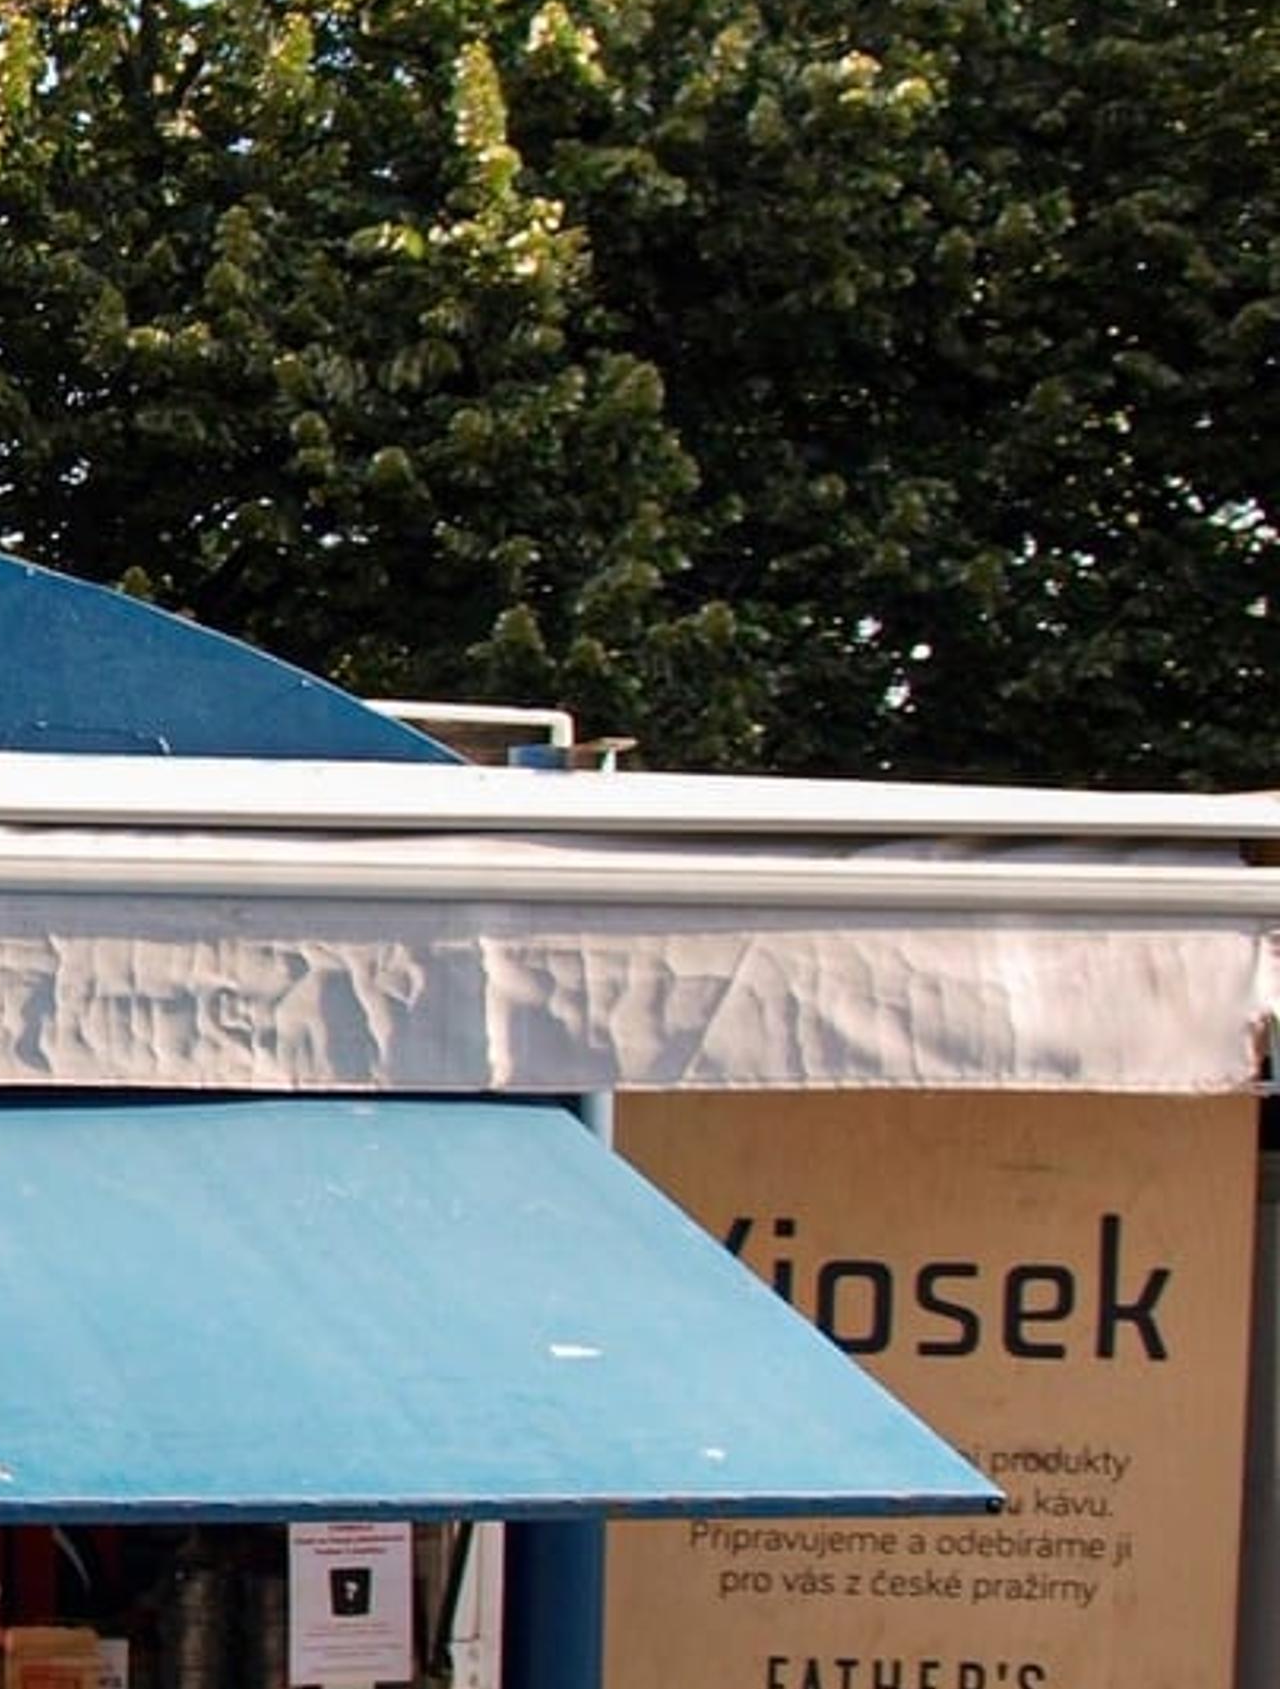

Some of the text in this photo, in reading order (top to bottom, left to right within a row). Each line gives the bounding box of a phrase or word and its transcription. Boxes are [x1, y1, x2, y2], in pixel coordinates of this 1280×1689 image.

[724, 1214, 1170, 1362] iosek
[991, 1445, 1132, 1483] produkty
[1035, 1488, 1113, 1518] kávu.
[907, 1532, 927, 1555] a
[719, 1566, 1098, 1610] pro vás z české pražírny
